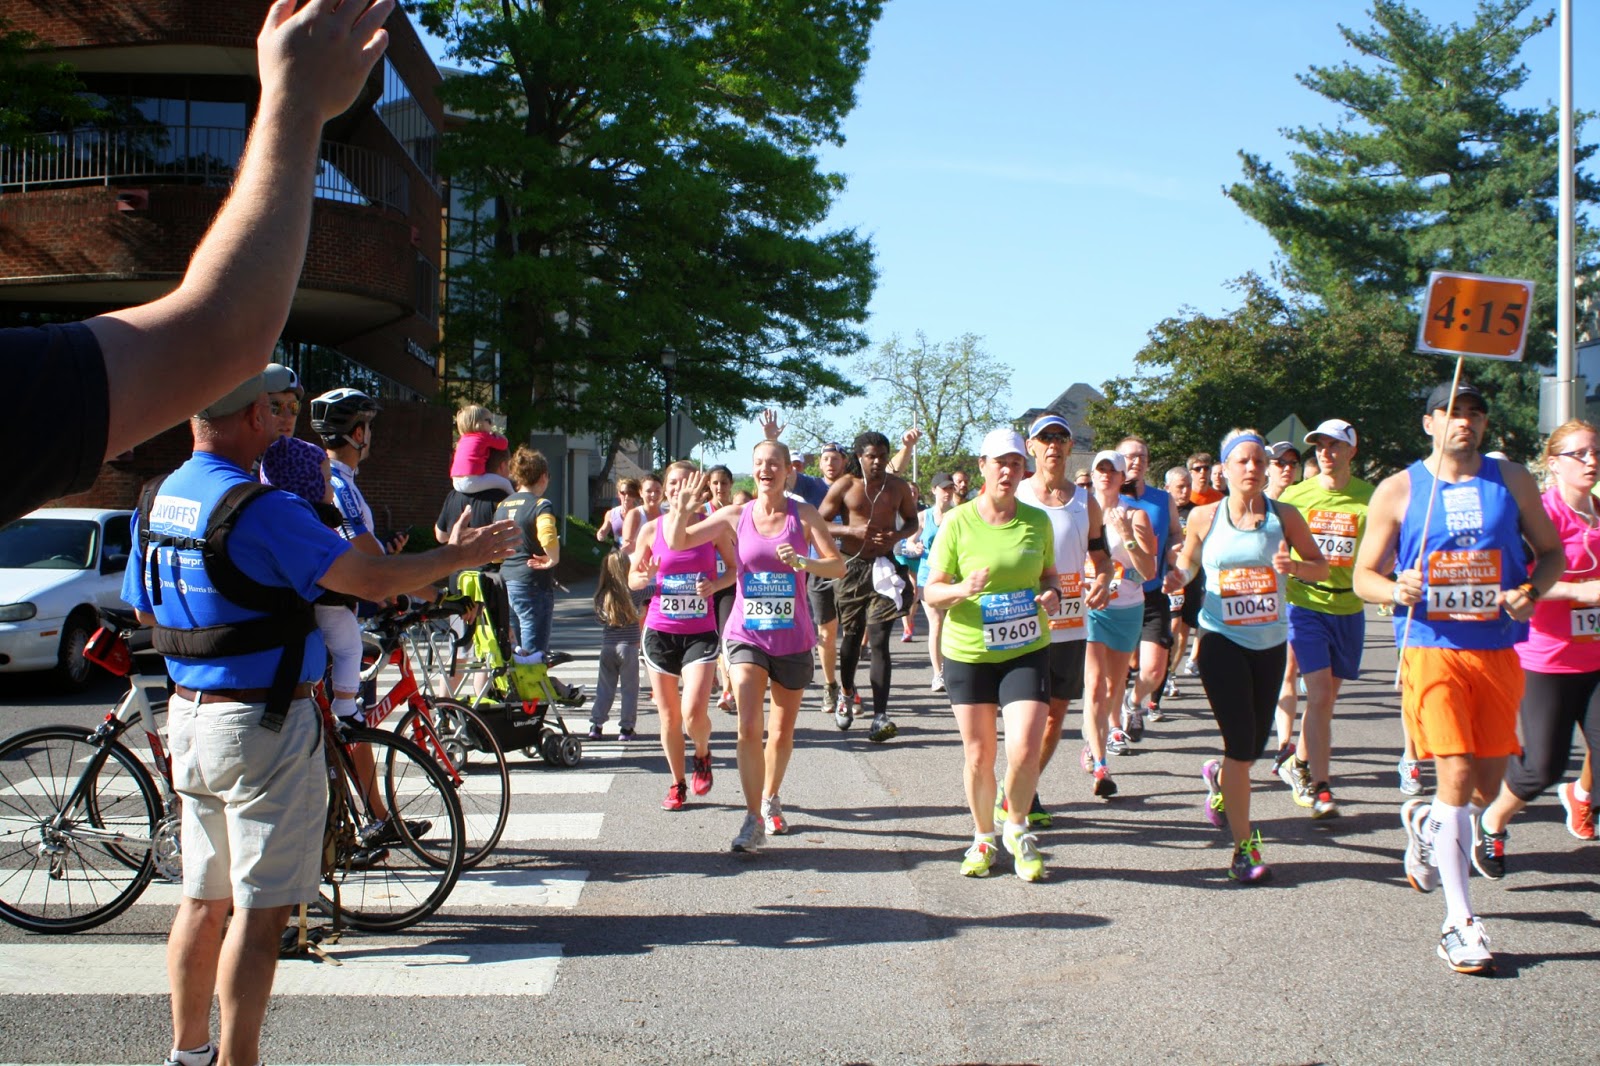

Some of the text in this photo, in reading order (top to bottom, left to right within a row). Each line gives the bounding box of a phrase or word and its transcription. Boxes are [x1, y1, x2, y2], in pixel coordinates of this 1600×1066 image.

[1433, 296, 1524, 336] 4:15
[1447, 511, 1483, 522] PACE
[1310, 522, 1355, 531] NASHVILLE
[1447, 519, 1483, 531] TEAM
[1318, 538, 1353, 553] 7063
[1466, 551, 1489, 560] JUDE
[1432, 567, 1497, 578] NASHVILLE
[187, 584, 207, 593] Harris
[1222, 580, 1274, 590] NASHVILLE
[1010, 591, 1027, 599] JUDE
[1434, 590, 1497, 608] 16182
[662, 598, 705, 611] 28146
[746, 601, 792, 615] 28368
[985, 602, 1036, 617] NASHVILLE
[1225, 597, 1276, 616] 10043
[988, 620, 1037, 643] 19609
